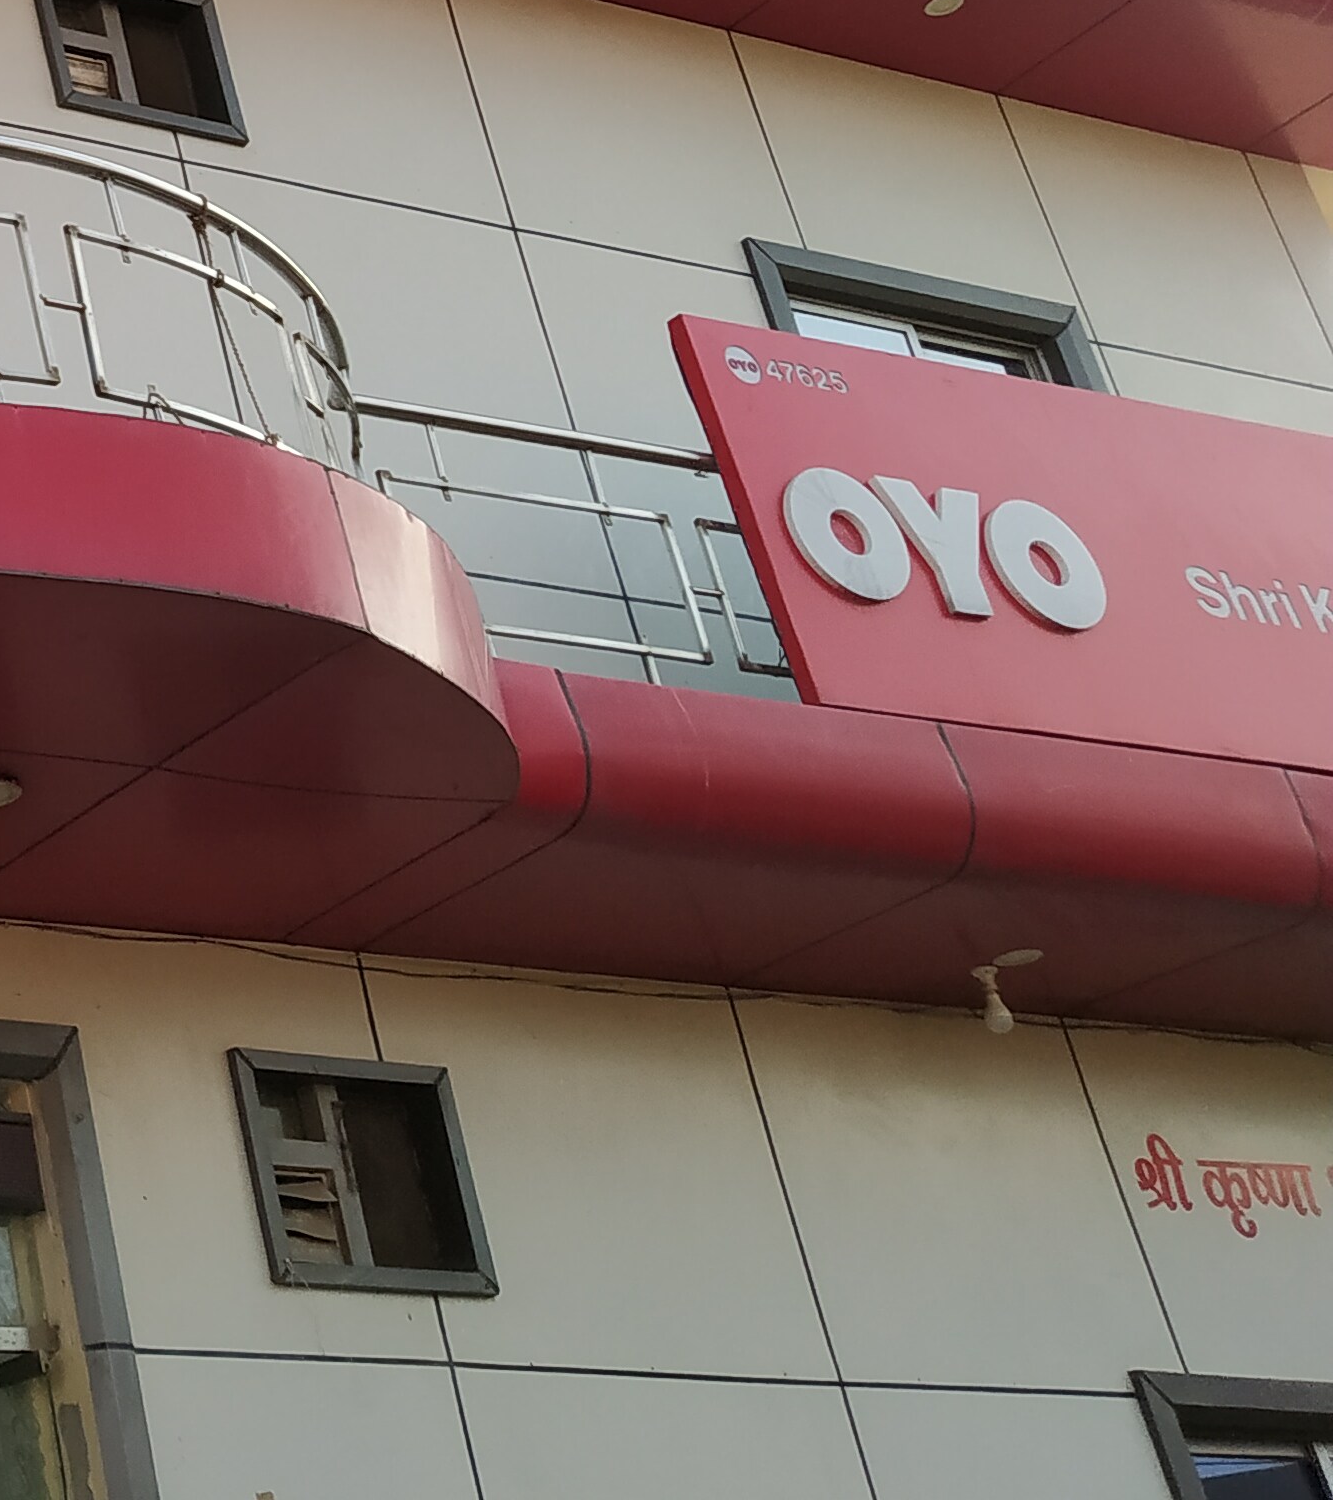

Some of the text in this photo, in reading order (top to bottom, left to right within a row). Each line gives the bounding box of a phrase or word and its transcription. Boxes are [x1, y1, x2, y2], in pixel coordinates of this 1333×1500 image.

[765, 358, 848, 395] 47625
[783, 466, 1108, 630] OYO
[1184, 564, 1303, 630] Shri
[1134, 1133, 1194, 1212] श्री
